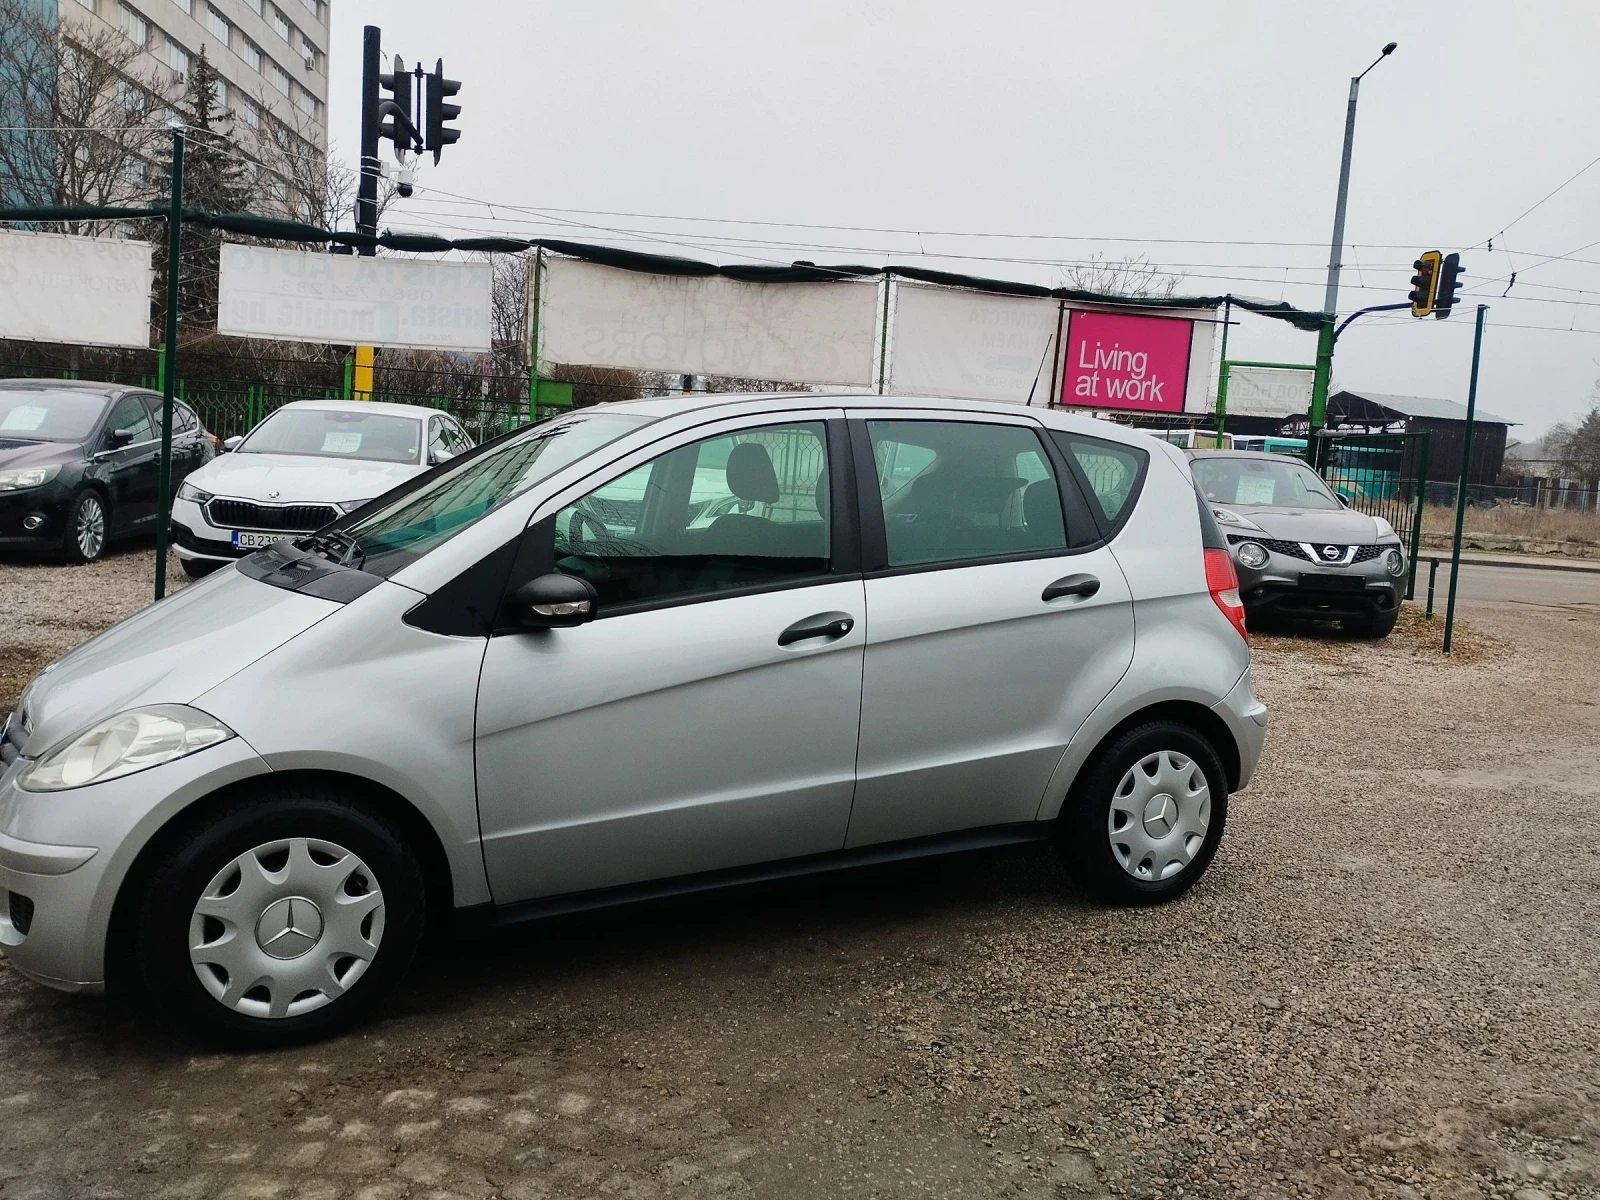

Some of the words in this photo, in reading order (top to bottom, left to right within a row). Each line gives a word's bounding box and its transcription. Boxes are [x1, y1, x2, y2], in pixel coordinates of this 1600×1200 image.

[1079, 340, 1148, 379] Living
[1075, 371, 1100, 397] at
[1106, 374, 1165, 403] work
[257, 535, 285, 547] 239
